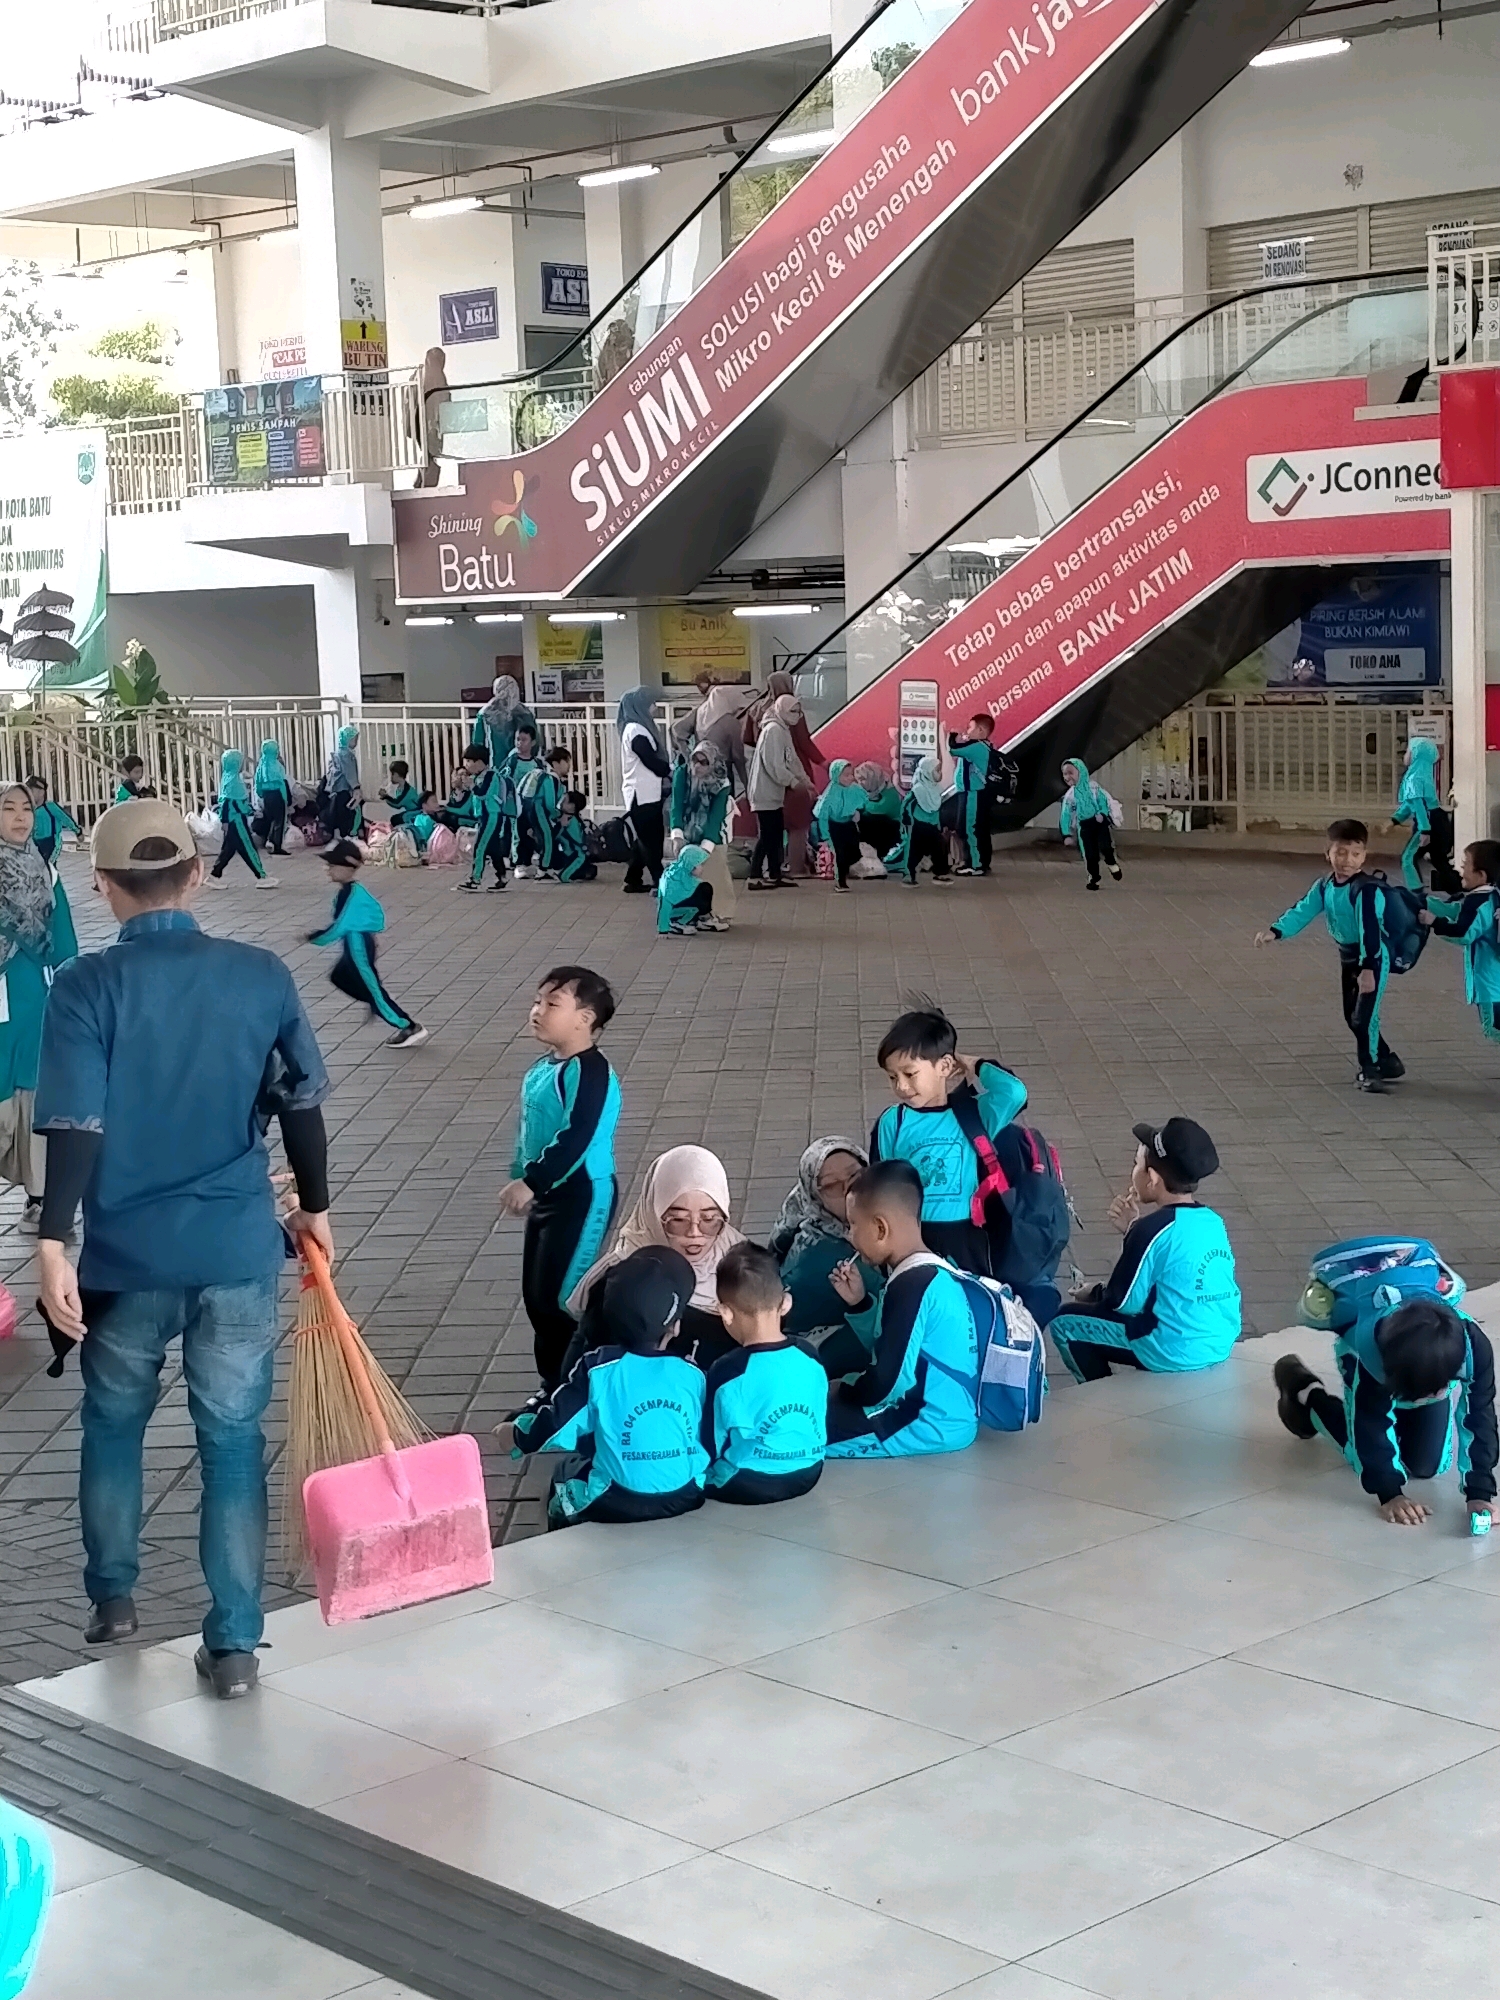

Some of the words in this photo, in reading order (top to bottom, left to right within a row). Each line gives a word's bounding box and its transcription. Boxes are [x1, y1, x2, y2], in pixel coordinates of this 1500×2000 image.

[700, 281, 765, 360] SOLUSI
[762, 237, 807, 294] bagi
[806, 134, 912, 255] pengusaha
[1267, 242, 1301, 260] SEDANG
[714, 330, 771, 393] Mikro
[770, 269, 825, 335] Kecil
[825, 251, 846, 280] &
[843, 138, 957, 259] Menengah
[465, 305, 494, 326] ASLI
[344, 352, 361, 366] BU
[365, 353, 387, 367] TIN
[628, 335, 683, 396] tabungan
[259, 418, 297, 431] SAMPAH
[569, 351, 712, 532] SiUMI
[596, 500, 639, 547] SIKLUS
[639, 459, 680, 503] MIKRO
[681, 421, 720, 461] KECIL
[29, 495, 52, 517] BATU
[1394, 493, 1424, 503] Powered
[1424, 492, 1434, 502] by
[428, 512, 483, 538] Shining
[439, 543, 517, 593] Batu
[944, 621, 996, 668] Tetap
[995, 573, 1054, 629] bebas
[1053, 470, 1183, 581] bertransaksi,
[945, 641, 1023, 710] dimanapun
[1023, 617, 1054, 647] dan
[1054, 573, 1111, 624] apapun
[1112, 518, 1178, 578] aktivitas
[1180, 483, 1221, 524] anda
[1309, 610, 1345, 622] PIRING
[1348, 608, 1385, 621] BERSIH
[1389, 607, 1426, 620] ALAMI
[986, 660, 1054, 719] bersama
[1057, 602, 1125, 667] BANK
[1127, 547, 1194, 615] JATIM
[1324, 626, 1362, 638] BUKAN
[1364, 625, 1410, 637] KIMIAWI
[1349, 654, 1377, 669] TOKO
[633, 1398, 682, 1416] CEMPAKA
[768, 1403, 810, 1424] CEMPAKA
[623, 1413, 637, 1429] 04
[621, 1431, 631, 1446] RA
